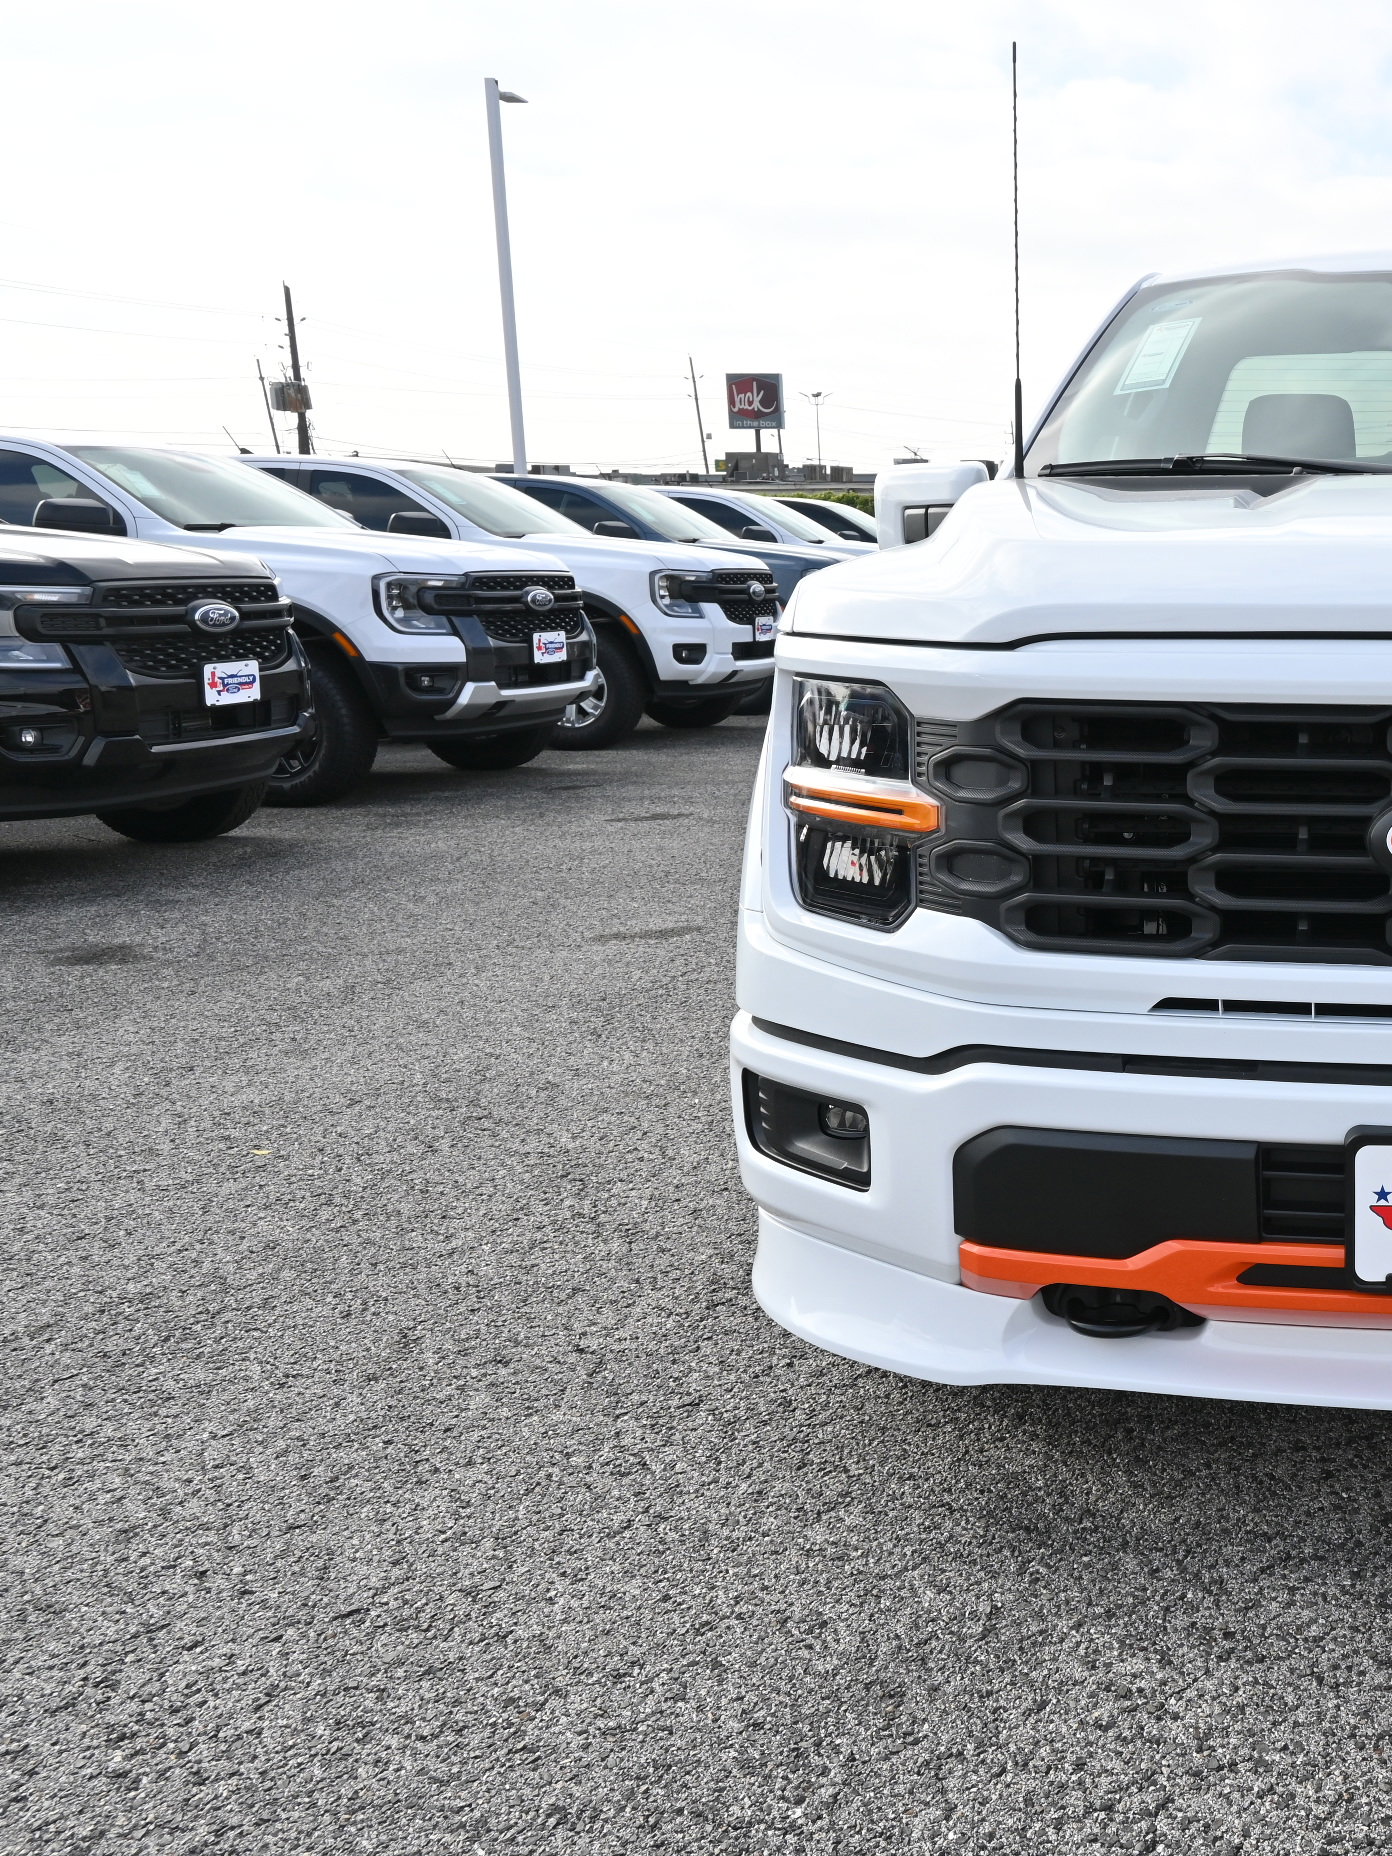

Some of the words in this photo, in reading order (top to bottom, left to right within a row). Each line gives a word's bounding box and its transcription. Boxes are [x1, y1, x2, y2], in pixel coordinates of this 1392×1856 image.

[730, 381, 777, 412] Jack
[535, 593, 550, 605] Ford
[208, 609, 231, 624] Ford
[224, 675, 254, 685] FRIENDLY
